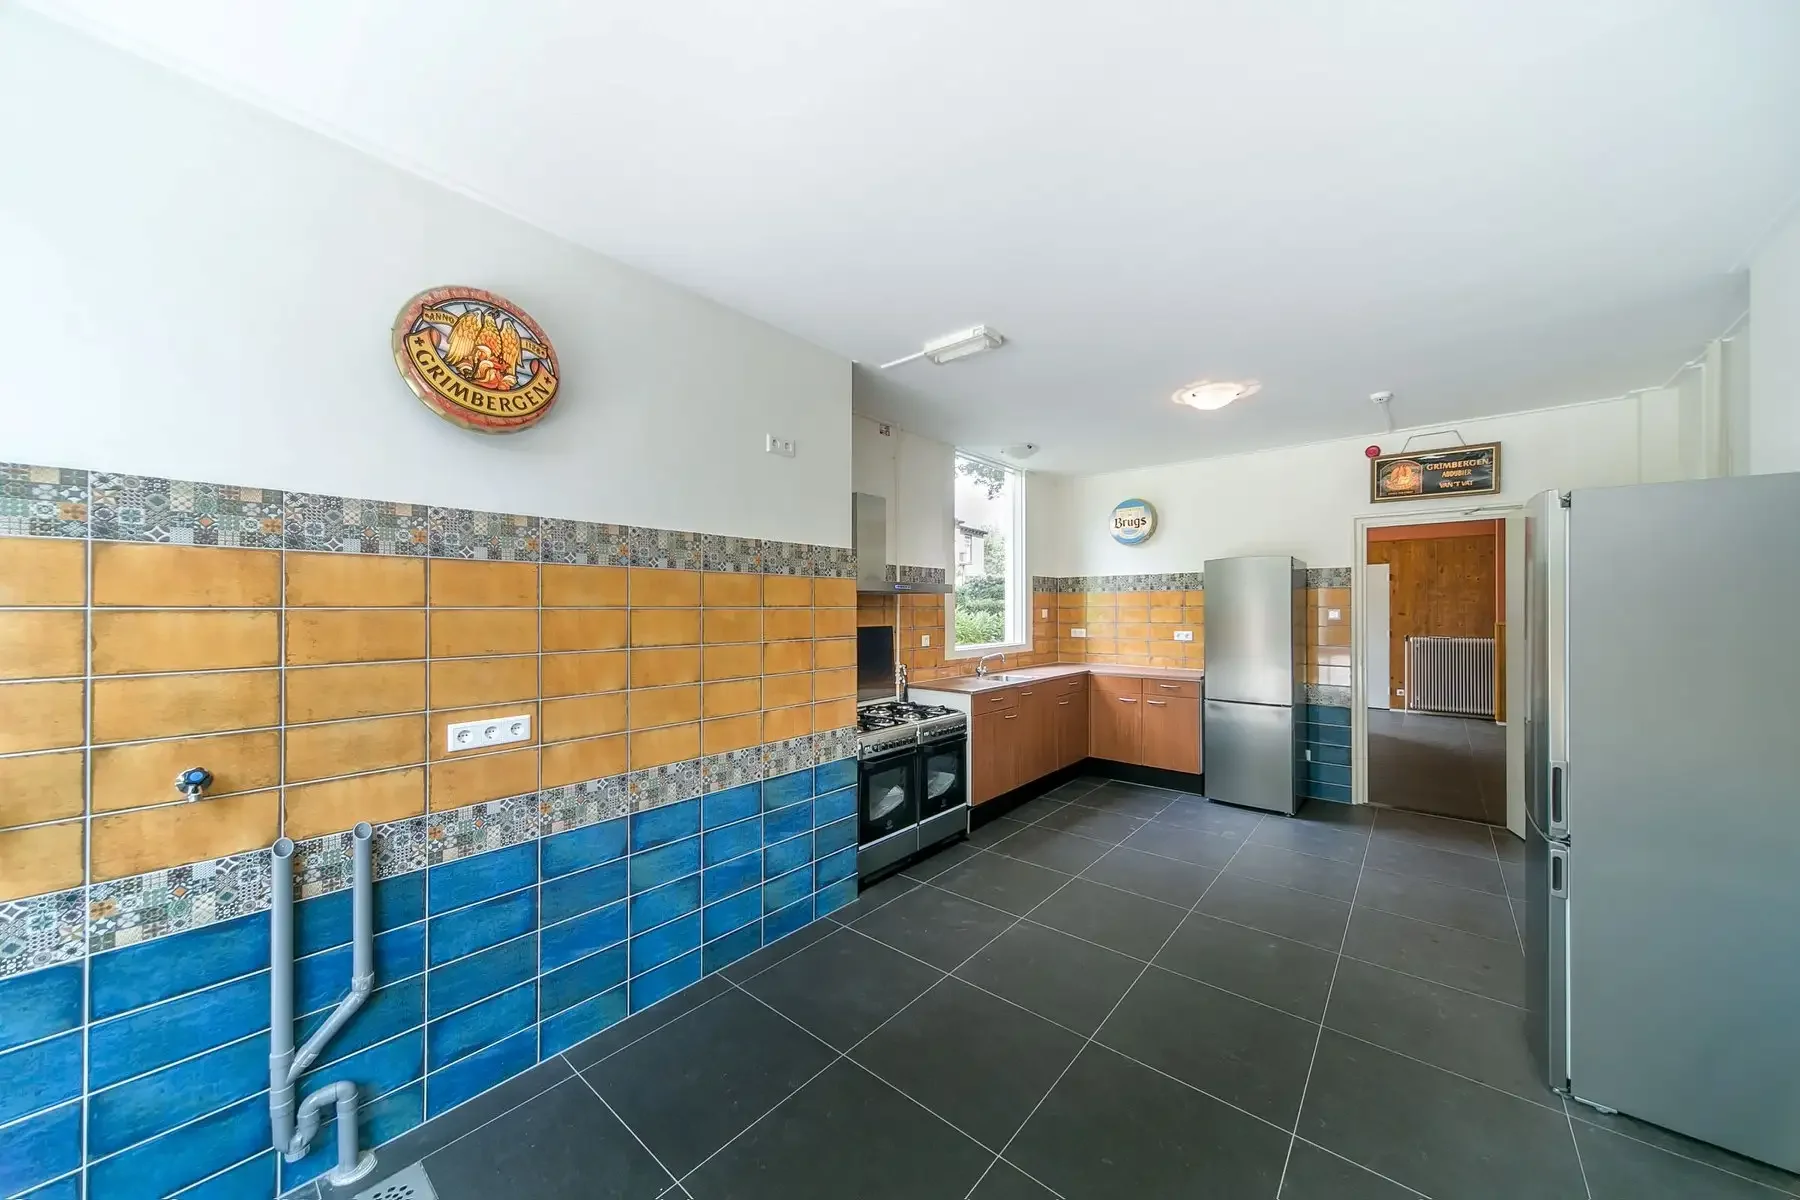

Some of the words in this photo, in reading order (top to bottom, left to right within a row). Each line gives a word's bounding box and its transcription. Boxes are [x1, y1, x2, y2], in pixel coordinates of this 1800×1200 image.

[430, 312, 455, 324] ANNO
[415, 349, 550, 413] GRIMBERGEN
[1426, 458, 1489, 471] GRIMBERGEN
[1114, 516, 1147, 529] Brugs
